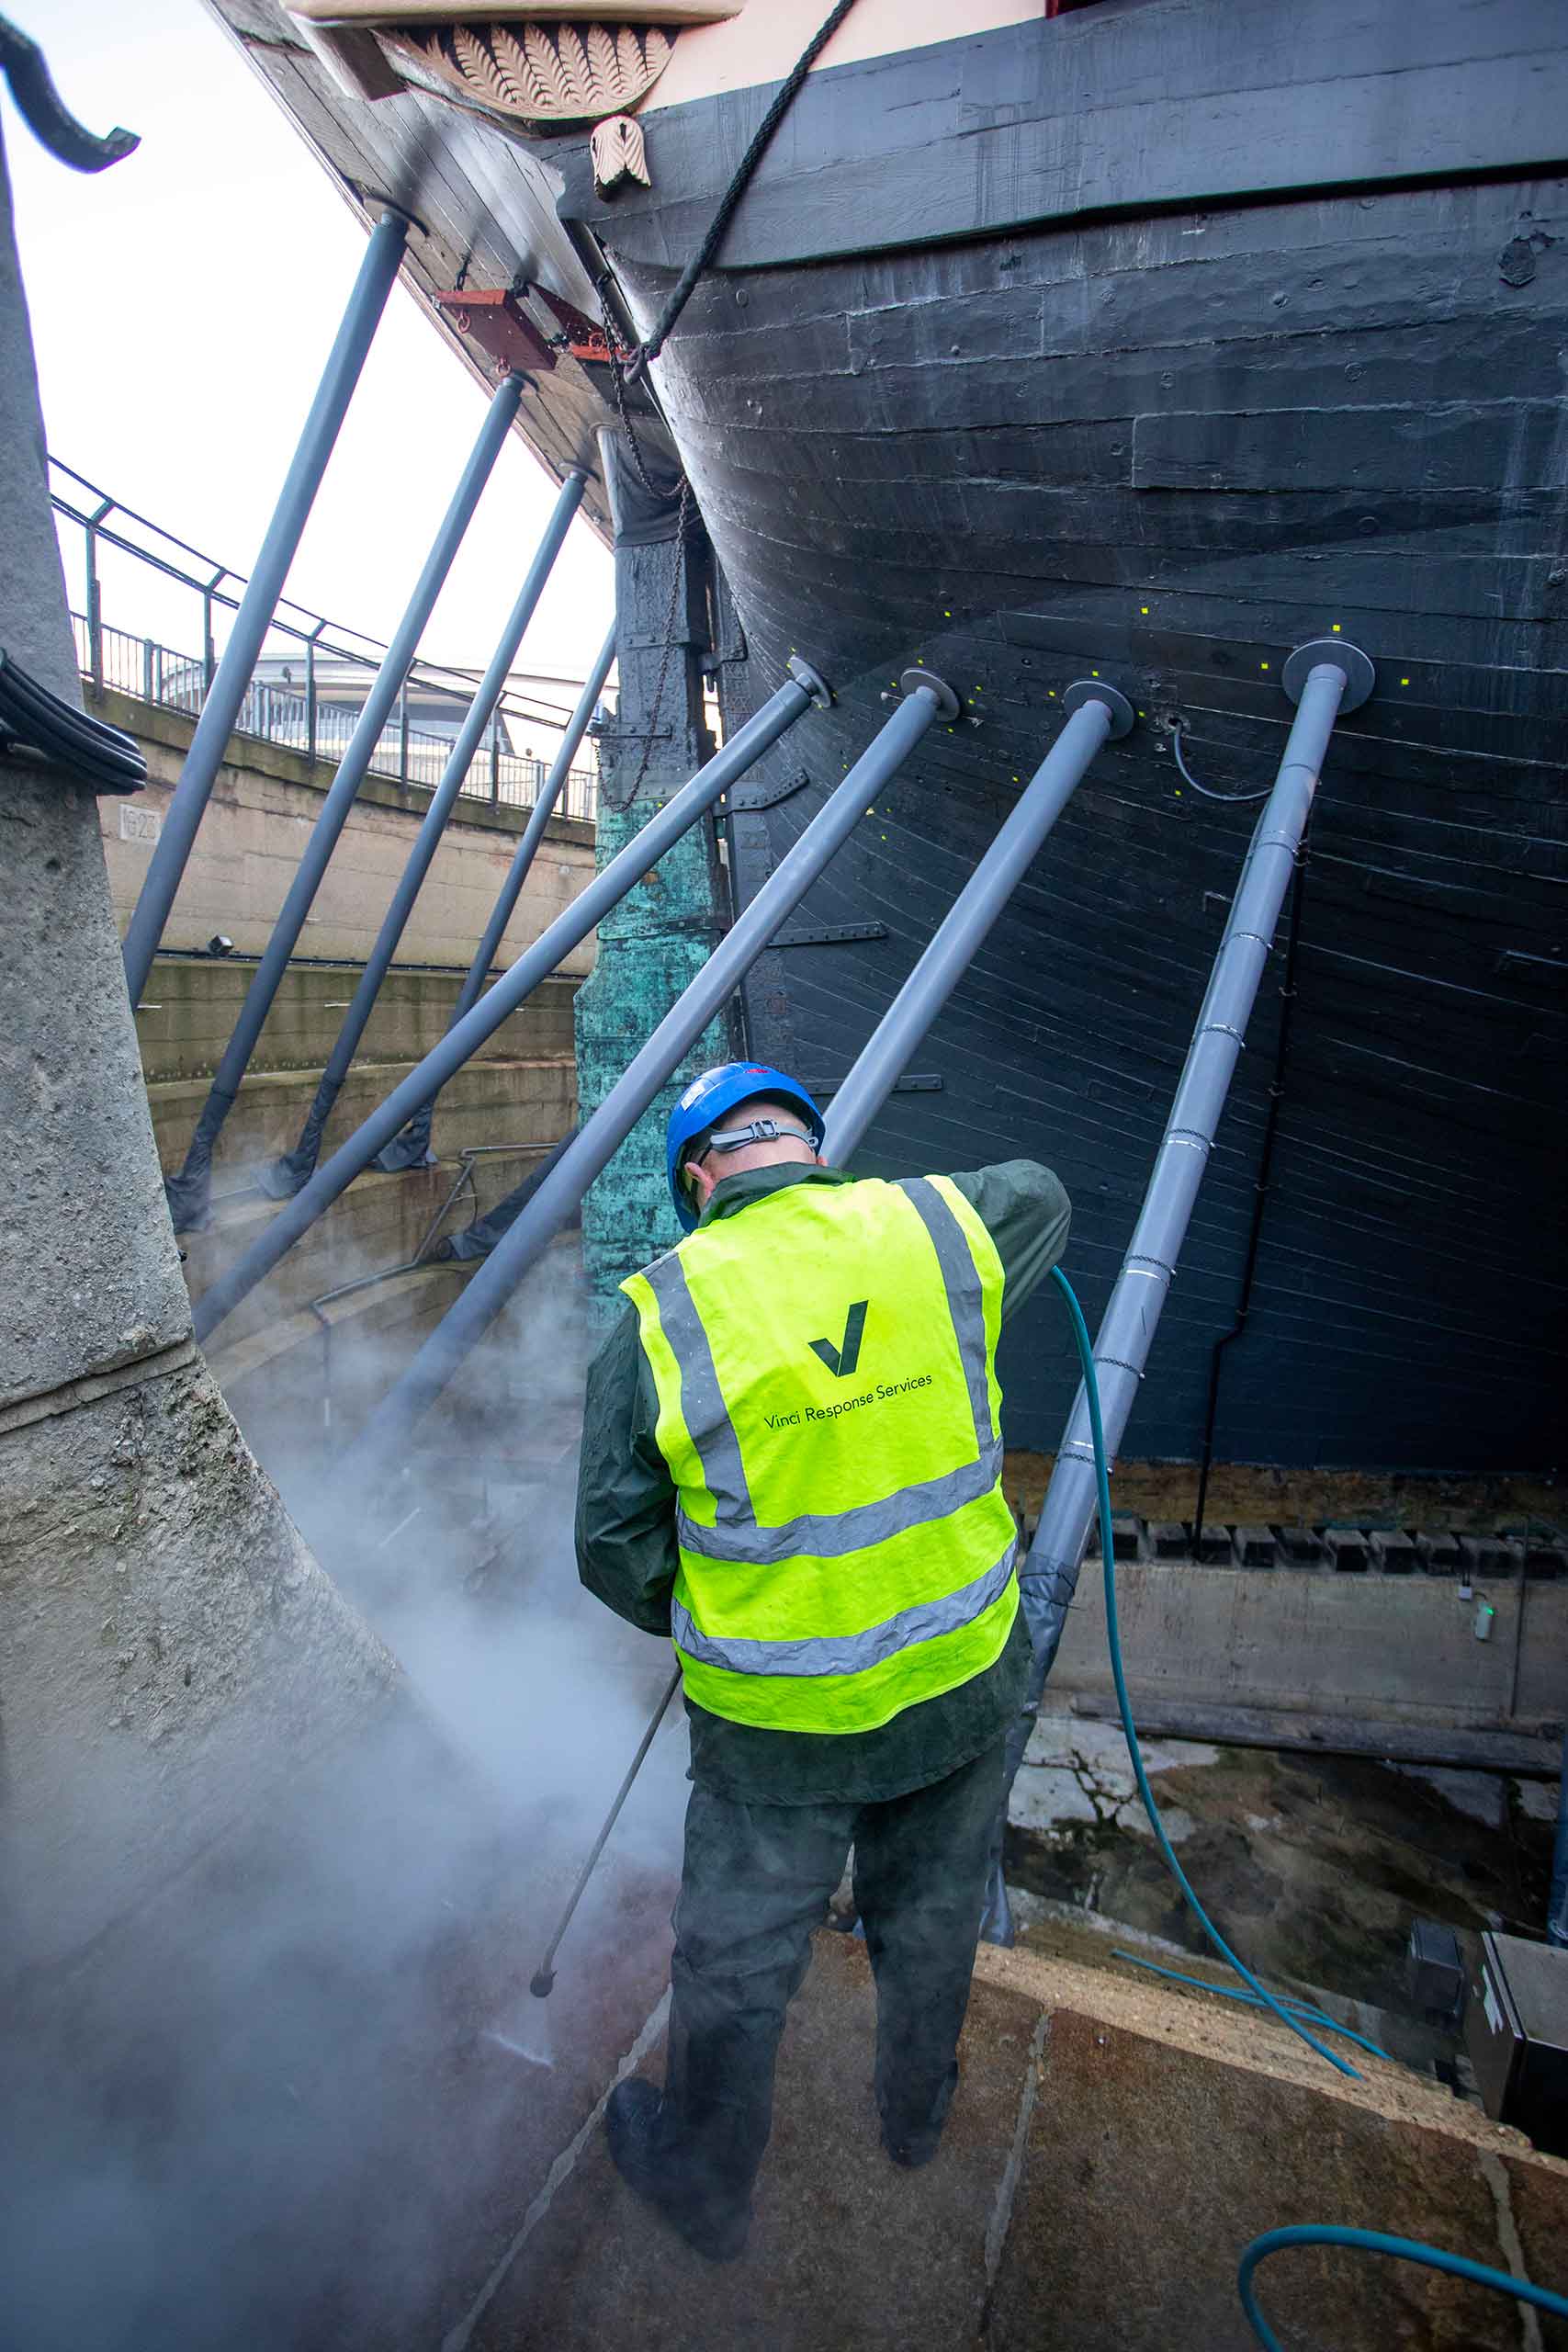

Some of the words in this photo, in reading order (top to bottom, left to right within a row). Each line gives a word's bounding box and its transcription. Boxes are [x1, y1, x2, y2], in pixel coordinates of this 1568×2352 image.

[763, 1410, 801, 1430] Vinci
[805, 1393, 874, 1421] Response
[875, 1374, 932, 1400] Services
